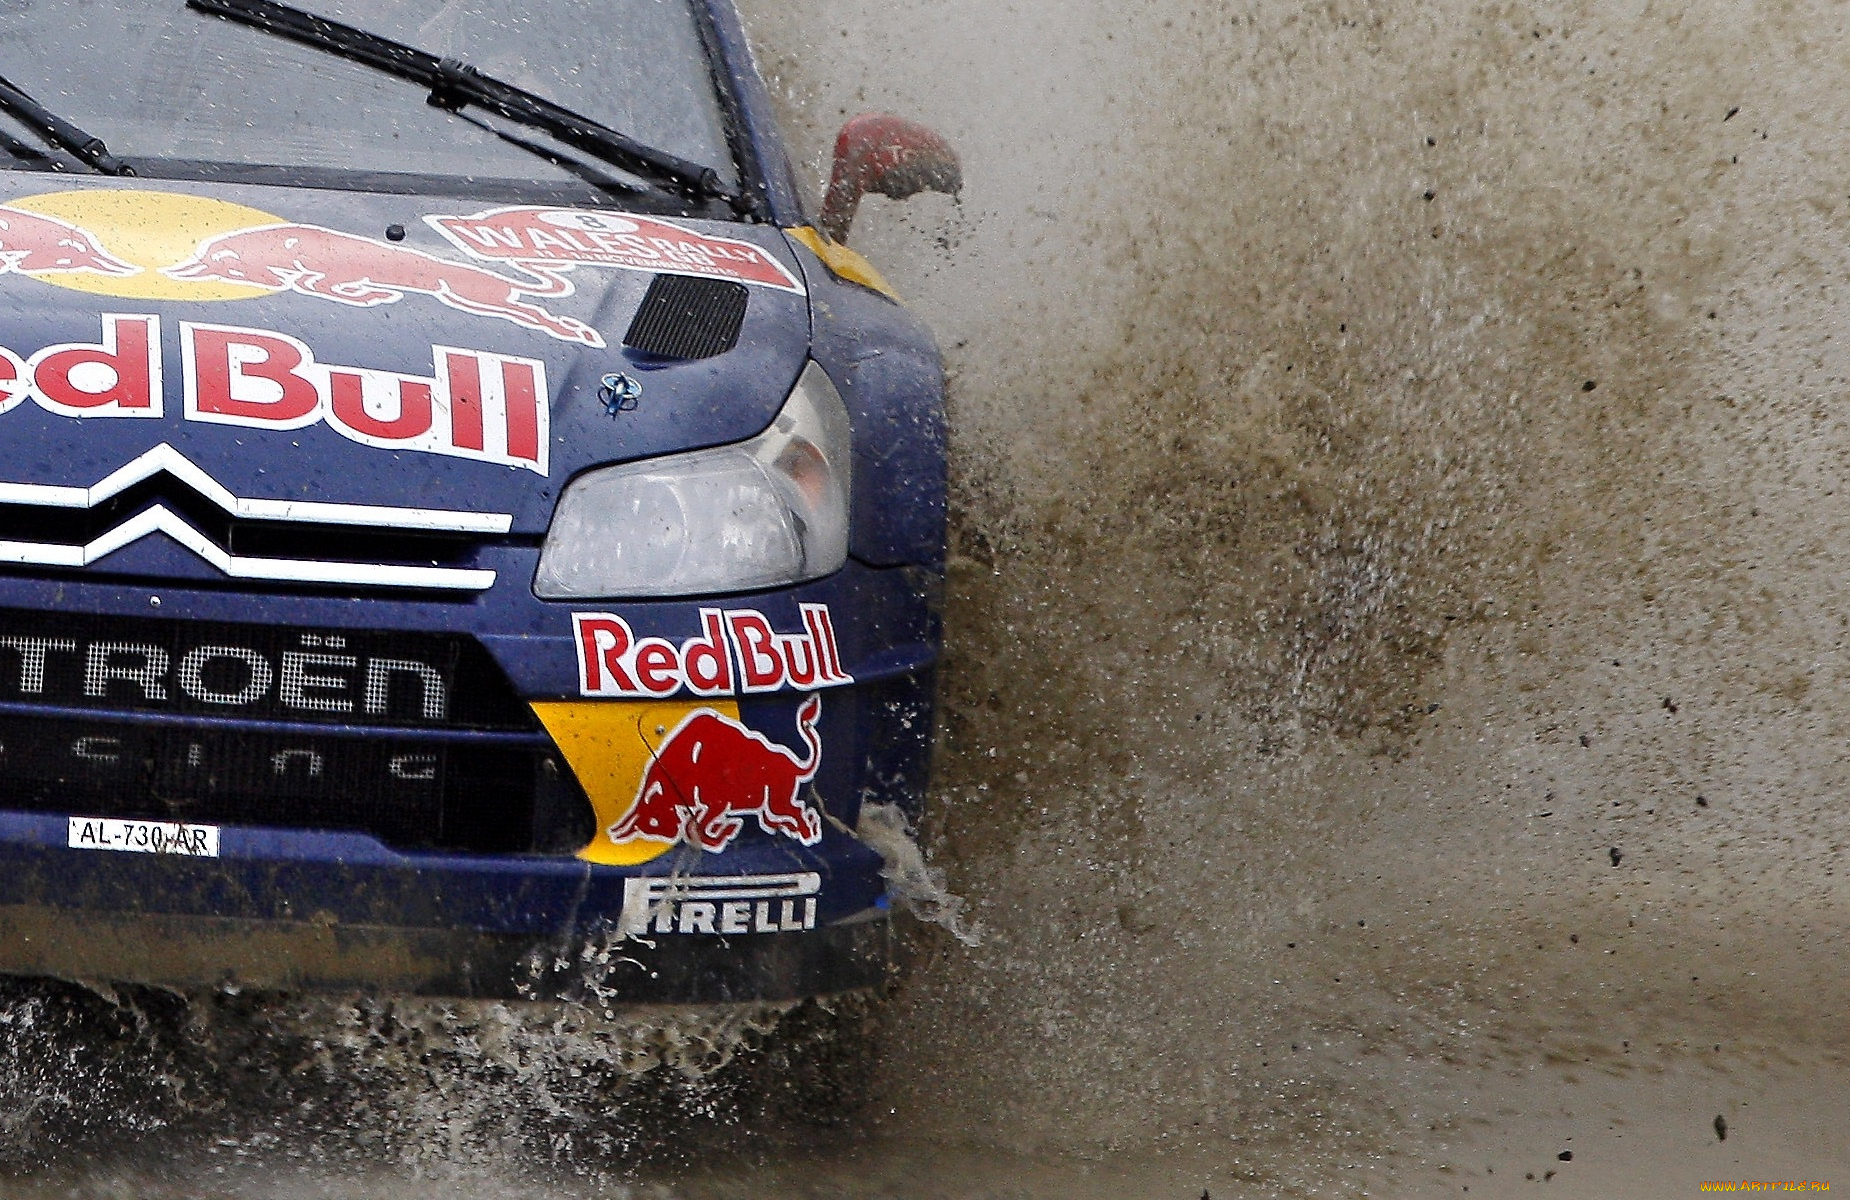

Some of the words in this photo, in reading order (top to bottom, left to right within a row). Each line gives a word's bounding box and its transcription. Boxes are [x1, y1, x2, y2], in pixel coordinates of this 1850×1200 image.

[450, 224, 662, 260] WALES
[646, 236, 760, 264] RALLY
[575, 214, 608, 229] 8
[184, 324, 545, 469] Bull
[574, 611, 732, 694] Red
[727, 605, 851, 691] Bull
[619, 871, 821, 935] PIRELLI
